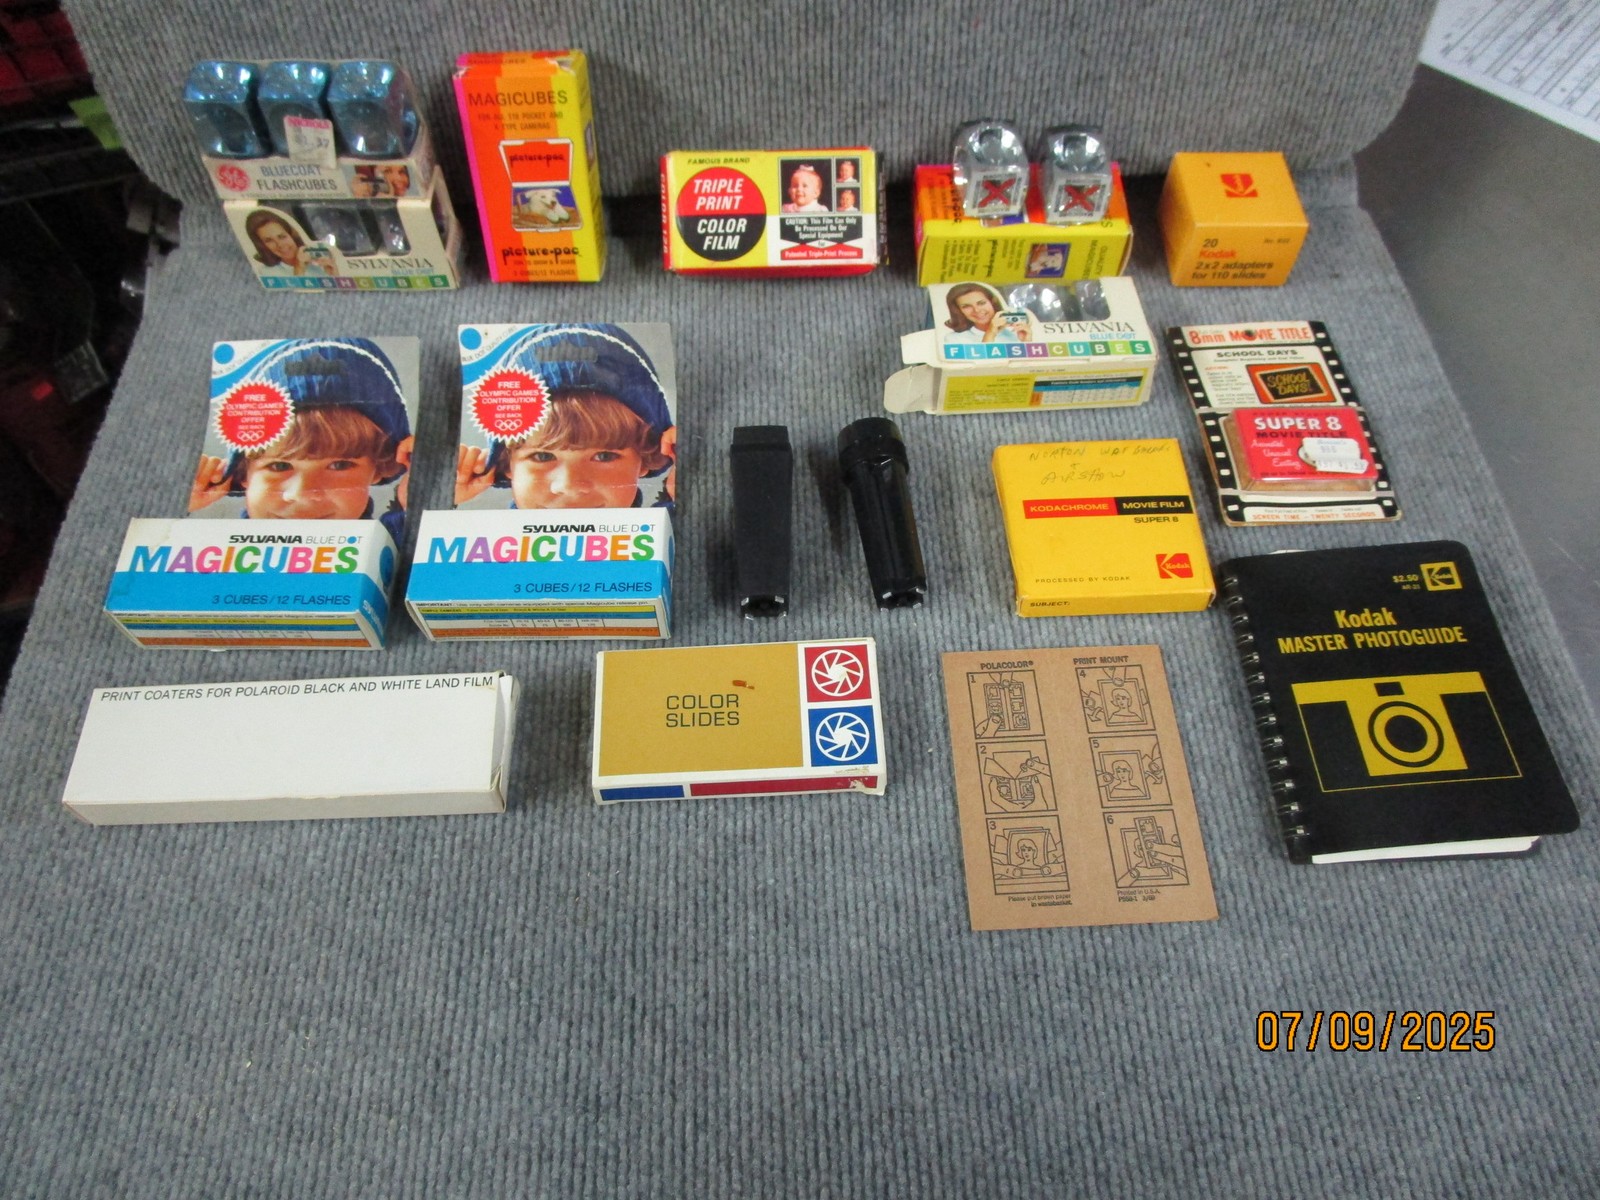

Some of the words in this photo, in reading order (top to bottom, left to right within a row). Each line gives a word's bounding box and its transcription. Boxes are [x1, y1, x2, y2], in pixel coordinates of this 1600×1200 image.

[467, 90, 568, 106] MAGICUBES
[260, 164, 322, 177] BLUECOAT
[256, 178, 338, 191] FLASHCUBES
[693, 178, 744, 194] TRIPLE
[695, 195, 743, 211] PRINT
[697, 218, 748, 235] COLOR
[703, 235, 741, 251] FILM
[1202, 238, 1219, 248] 20
[502, 246, 580, 266] picture-pac
[346, 257, 434, 269] SYLVANIA
[1222, 260, 1274, 271] adapters
[1191, 271, 1208, 280] for
[1211, 271, 1230, 280] 110
[266, 276, 445, 288] FLASHCUBES
[1043, 322, 1136, 334] SYLVANIA
[1089, 333, 1115, 341] BLUE
[1188, 330, 1226, 345] 8mm
[1277, 326, 1312, 340] TITLE
[949, 341, 1147, 358] FLASHCUBES
[1216, 350, 1265, 358] SCHOOL
[498, 381, 521, 389] FREE
[1267, 371, 1309, 388] SCHOOL
[244, 393, 267, 402] FREE
[1254, 416, 1321, 430] SUPER
[1325, 416, 1342, 430] 8
[1030, 503, 1109, 512] KODACHROME
[1122, 501, 1158, 509] MOVIE
[1134, 516, 1170, 524] SUPER
[522, 524, 596, 533] SYLVANIA
[598, 524, 628, 533] BLUE
[229, 535, 302, 544] SYLVANIA
[306, 535, 335, 544] BLUE
[427, 534, 655, 563] MAGICUBES
[128, 545, 360, 574] MAGICUBES
[1165, 562, 1190, 570] Kodak
[514, 583, 522, 593] 3
[595, 582, 653, 592] FLASHES
[212, 595, 220, 605] 3
[292, 595, 352, 605] FLASHES
[1334, 607, 1397, 629] Kodak
[1277, 634, 1348, 654] MASTER
[1353, 626, 1468, 649] PHOTOGUIDE
[1073, 657, 1097, 665] PRINT
[1099, 655, 1129, 664] MOUNT
[970, 674, 976, 683] 1
[1079, 670, 1087, 679] 4
[101, 690, 141, 701] PRINT
[144, 688, 203, 700] COATERS
[206, 687, 231, 698] FOR
[235, 684, 300, 697] POLAROID
[304, 682, 345, 694] BLACK
[349, 681, 377, 692] AND
[381, 679, 421, 691] WHITE
[426, 677, 460, 689] LAND
[464, 676, 493, 687] FILM
[666, 693, 740, 710] COLOR
[665, 711, 740, 728] SLIDES
[980, 745, 987, 755] 2
[1092, 739, 1100, 749] 5
[989, 820, 997, 831] 3
[1106, 814, 1114, 825] 6
